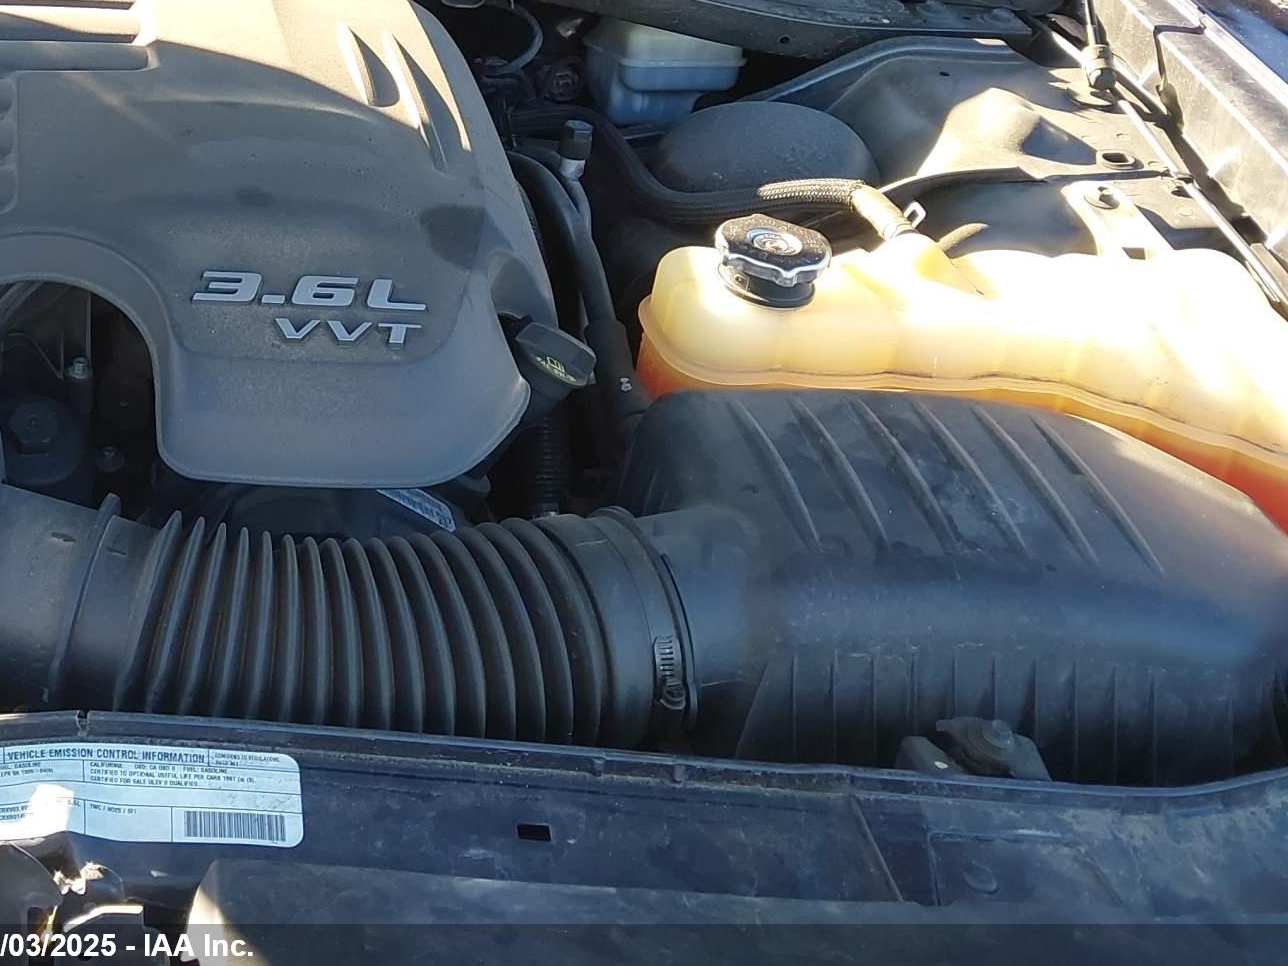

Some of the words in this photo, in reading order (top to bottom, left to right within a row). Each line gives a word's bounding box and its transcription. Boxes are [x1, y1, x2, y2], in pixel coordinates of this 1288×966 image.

[191, 270, 427, 311] 3.6L
[274, 317, 423, 347] VVT
[8, 749, 46, 760] VEHICLE
[49, 748, 93, 758] EMISSION
[96, 748, 138, 760] CONTROL
[142, 751, 205, 763] INFORMATION
